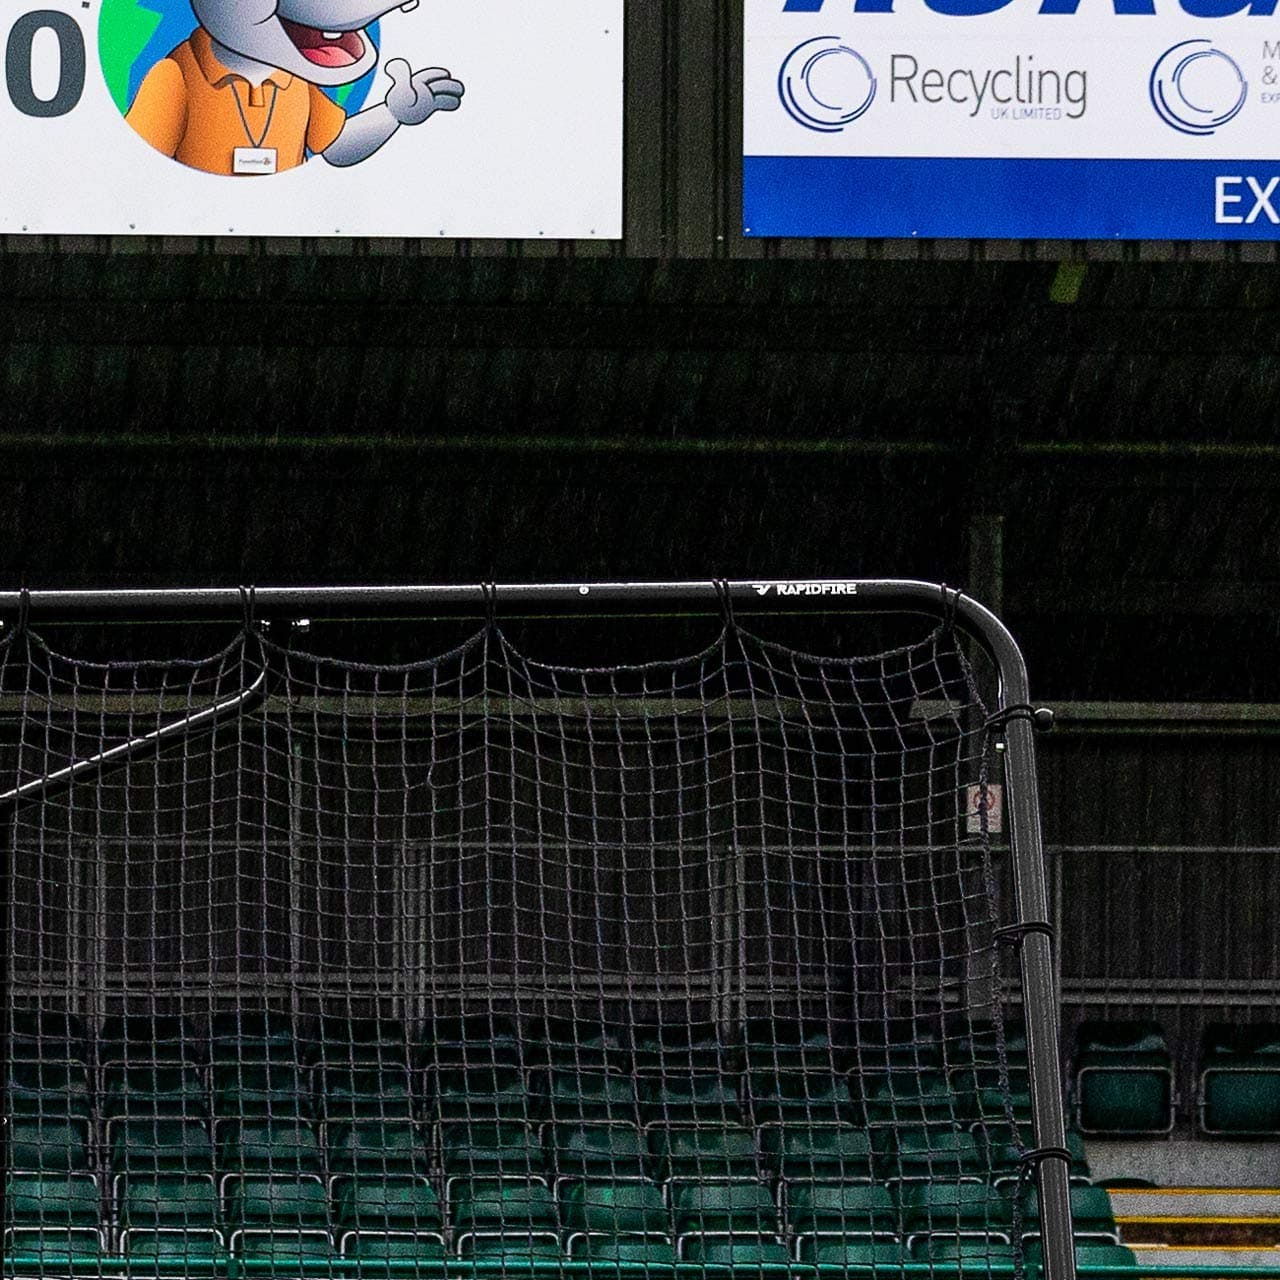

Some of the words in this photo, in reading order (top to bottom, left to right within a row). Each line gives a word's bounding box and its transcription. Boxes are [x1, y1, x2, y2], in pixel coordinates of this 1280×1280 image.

[1262, 66, 1278, 85] &
[890, 55, 1087, 118] Recycling
[991, 108, 1009, 120] UK
[1013, 108, 1061, 120] LIMITED
[777, 583, 857, 596] RAPIDFIRE
